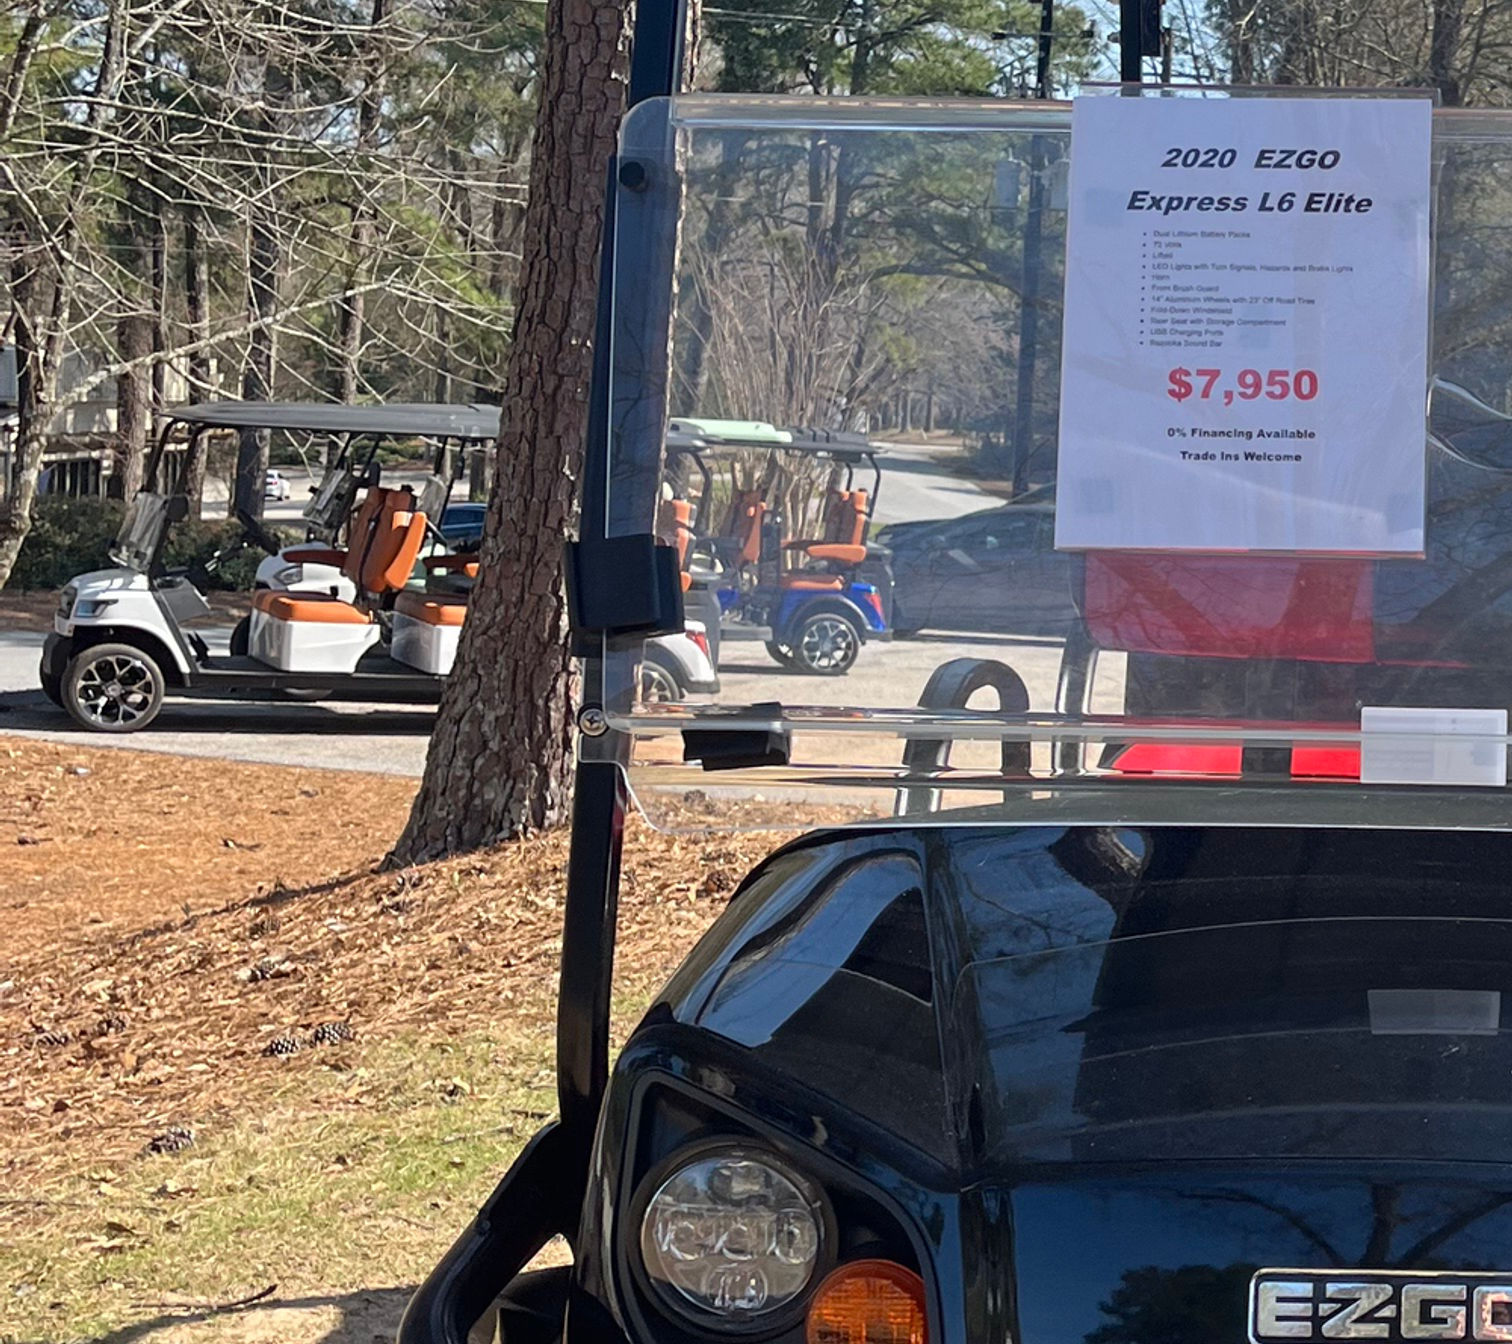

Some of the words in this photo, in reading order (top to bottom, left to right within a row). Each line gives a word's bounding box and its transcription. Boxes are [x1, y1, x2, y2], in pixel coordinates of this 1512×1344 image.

[1161, 148, 1238, 169] 2020
[1254, 149, 1341, 170] EZGO
[1126, 190, 1249, 216] Express
[1257, 192, 1296, 213] L6
[1303, 193, 1373, 213] Elite
[1201, 231, 1225, 239] Battery
[1206, 318, 1234, 326] Storage
[1168, 367, 1319, 406] $7,950
[1167, 428, 1187, 438] 0%
[1191, 428, 1253, 440] Financing
[1257, 429, 1316, 439] Available
[1180, 451, 1216, 461] Trade
[1221, 452, 1240, 461] Ins
[1244, 452, 1302, 462] Welcome
